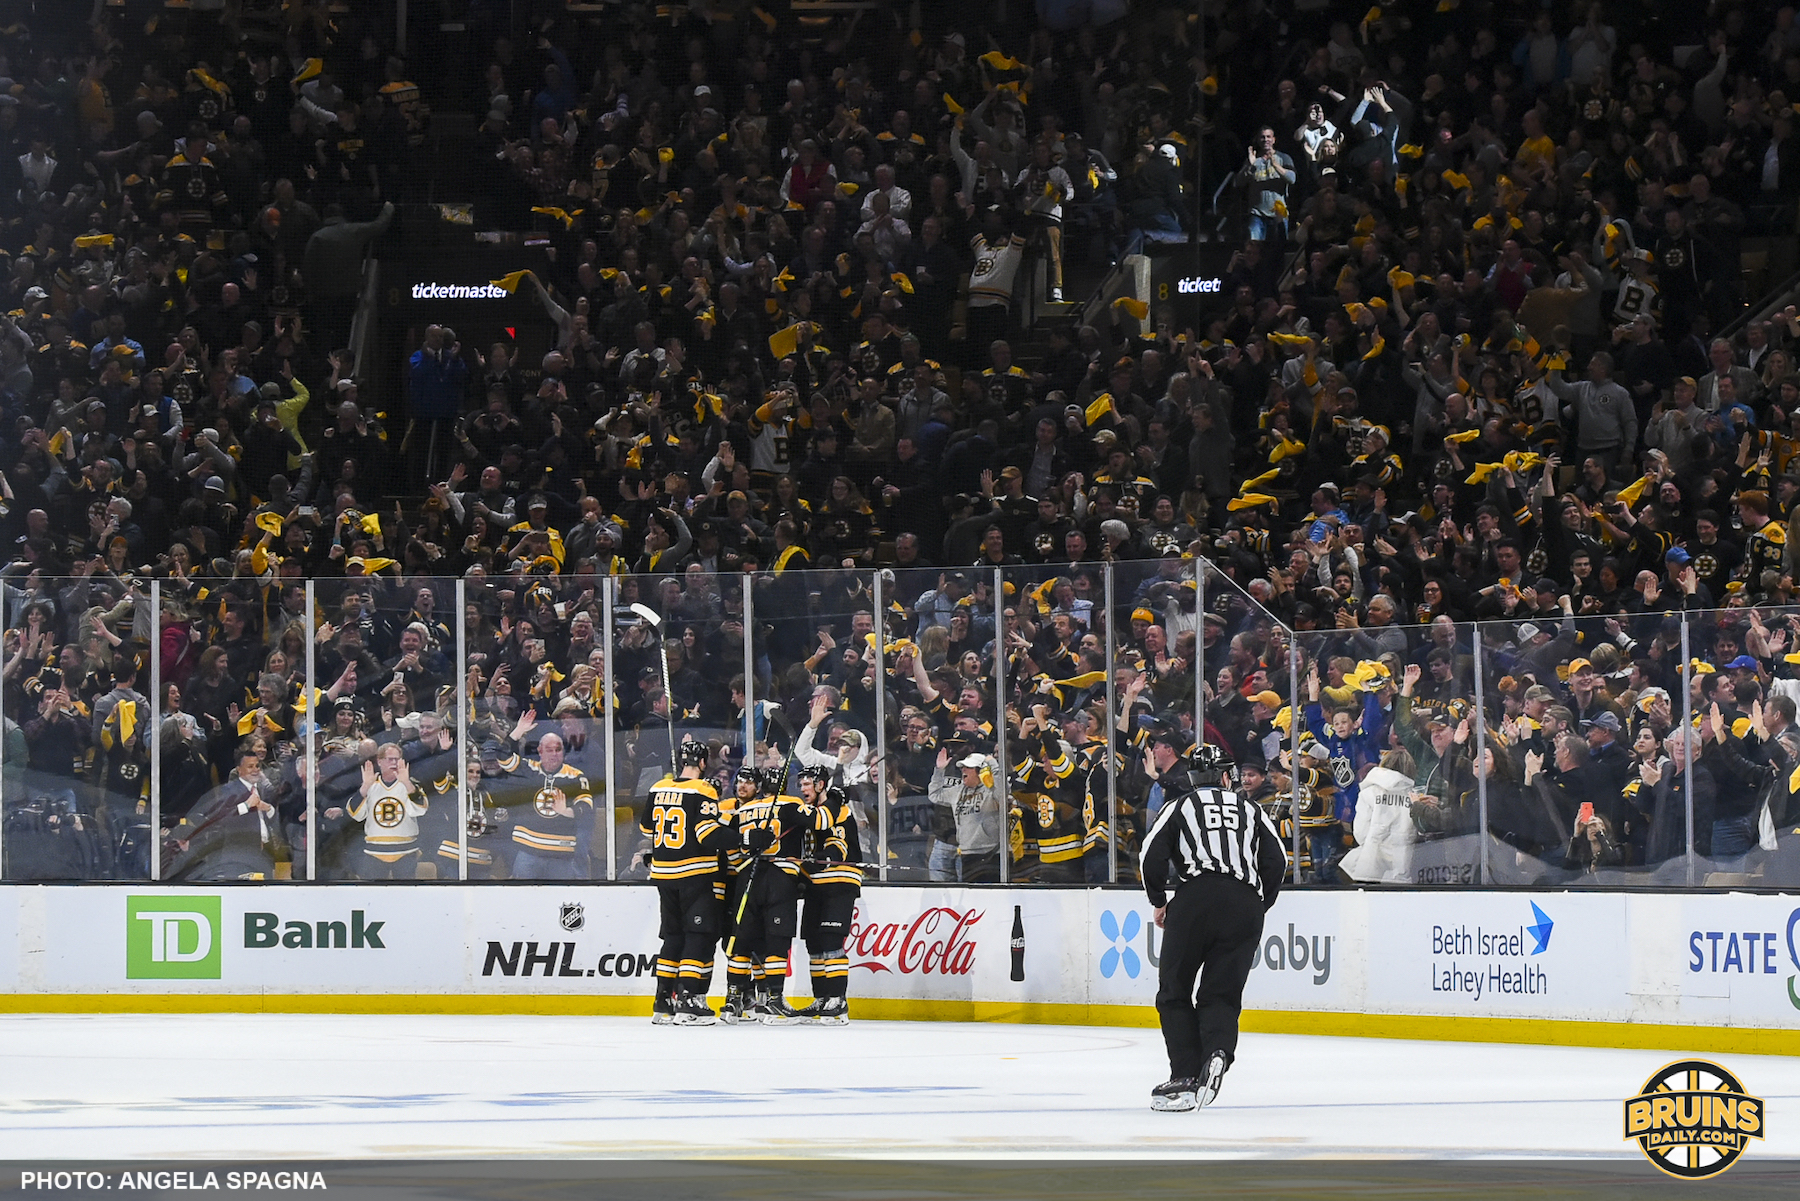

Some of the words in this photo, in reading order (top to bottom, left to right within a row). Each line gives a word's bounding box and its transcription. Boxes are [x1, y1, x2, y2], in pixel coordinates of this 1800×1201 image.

[1177, 277, 1222, 293] ticket
[653, 792, 684, 806] CHARA
[699, 801, 718, 817] 33
[1375, 793, 1411, 809] BRUINS
[652, 805, 687, 850] 33
[1203, 804, 1240, 830] 65
[136, 911, 212, 962] TD
[244, 909, 387, 950] Bank
[843, 907, 987, 976] oca-Cola
[1433, 924, 1473, 955] Beth
[1478, 925, 1525, 957] Israel
[1689, 931, 1777, 974] STATE
[482, 941, 660, 977] NHL.COM
[1433, 961, 1485, 1002] Lahey
[1488, 962, 1547, 995] Health
